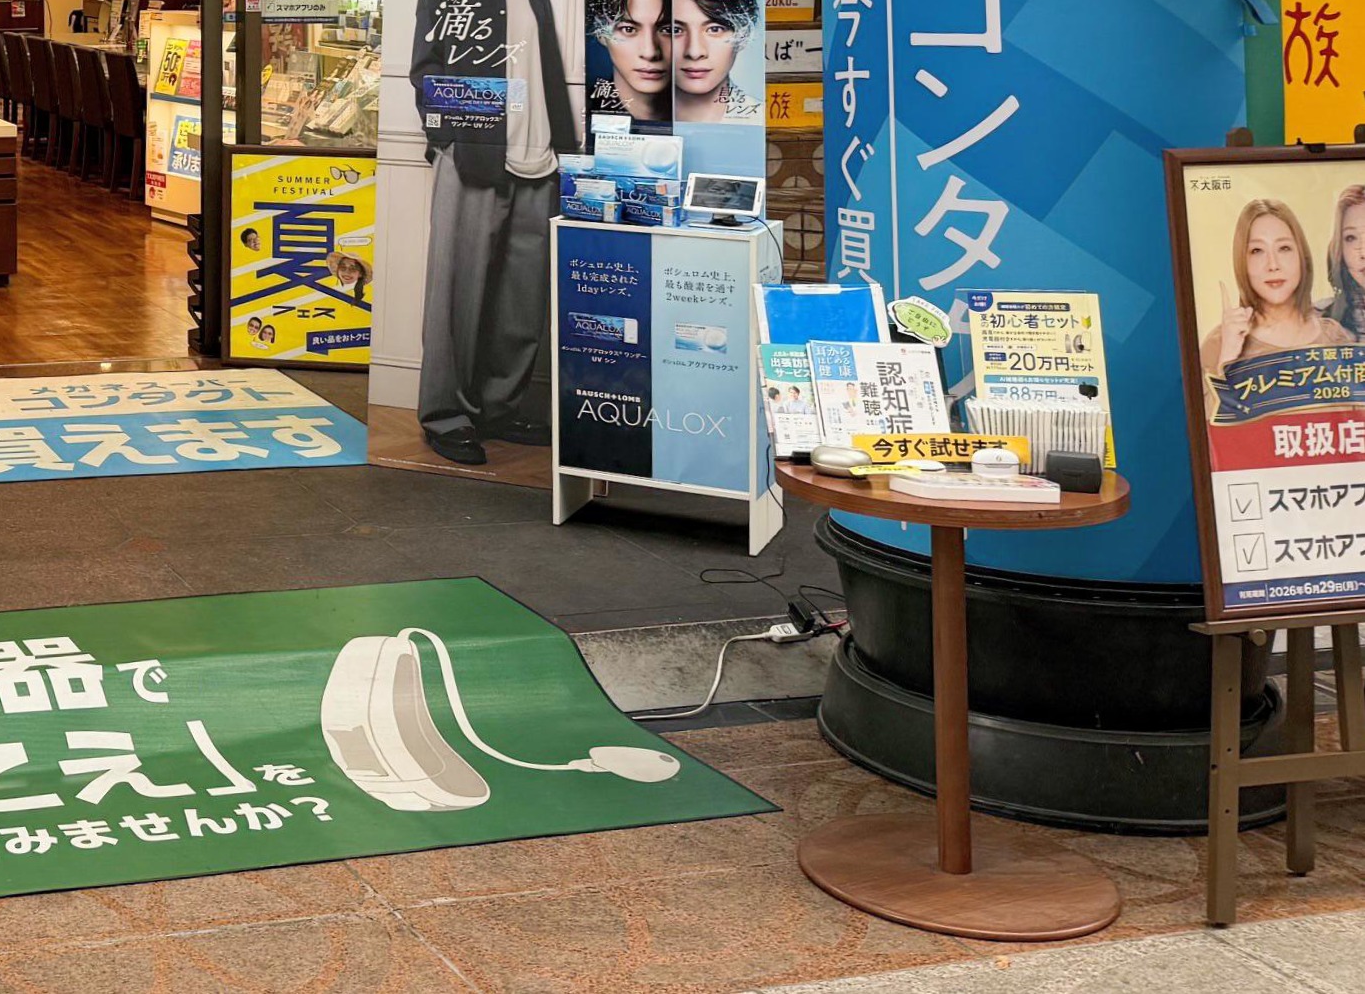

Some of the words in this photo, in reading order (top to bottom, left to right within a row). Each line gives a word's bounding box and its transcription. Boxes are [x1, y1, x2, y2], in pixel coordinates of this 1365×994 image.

[447, 40, 528, 68] レンズ
[434, 87, 506, 100] AQUALOX
[277, 175, 331, 184] SUMMER
[273, 187, 335, 196] FESTIVAL
[230, 201, 372, 313] 夏
[570, 271, 639, 285] 最も完成された
[272, 304, 336, 320] フェス
[989, 313, 1080, 329] 初心者セット
[1009, 352, 1070, 371] 20万円
[1305, 347, 1354, 361] 大阪市
[819, 365, 853, 377] 健康
[10, 383, 295, 412] コンタクト
[860, 381, 883, 416] 難聴
[1313, 387, 1351, 399] 2026
[576, 400, 730, 438] AQUALOX
[1272, 420, 1365, 458] 取扱店
